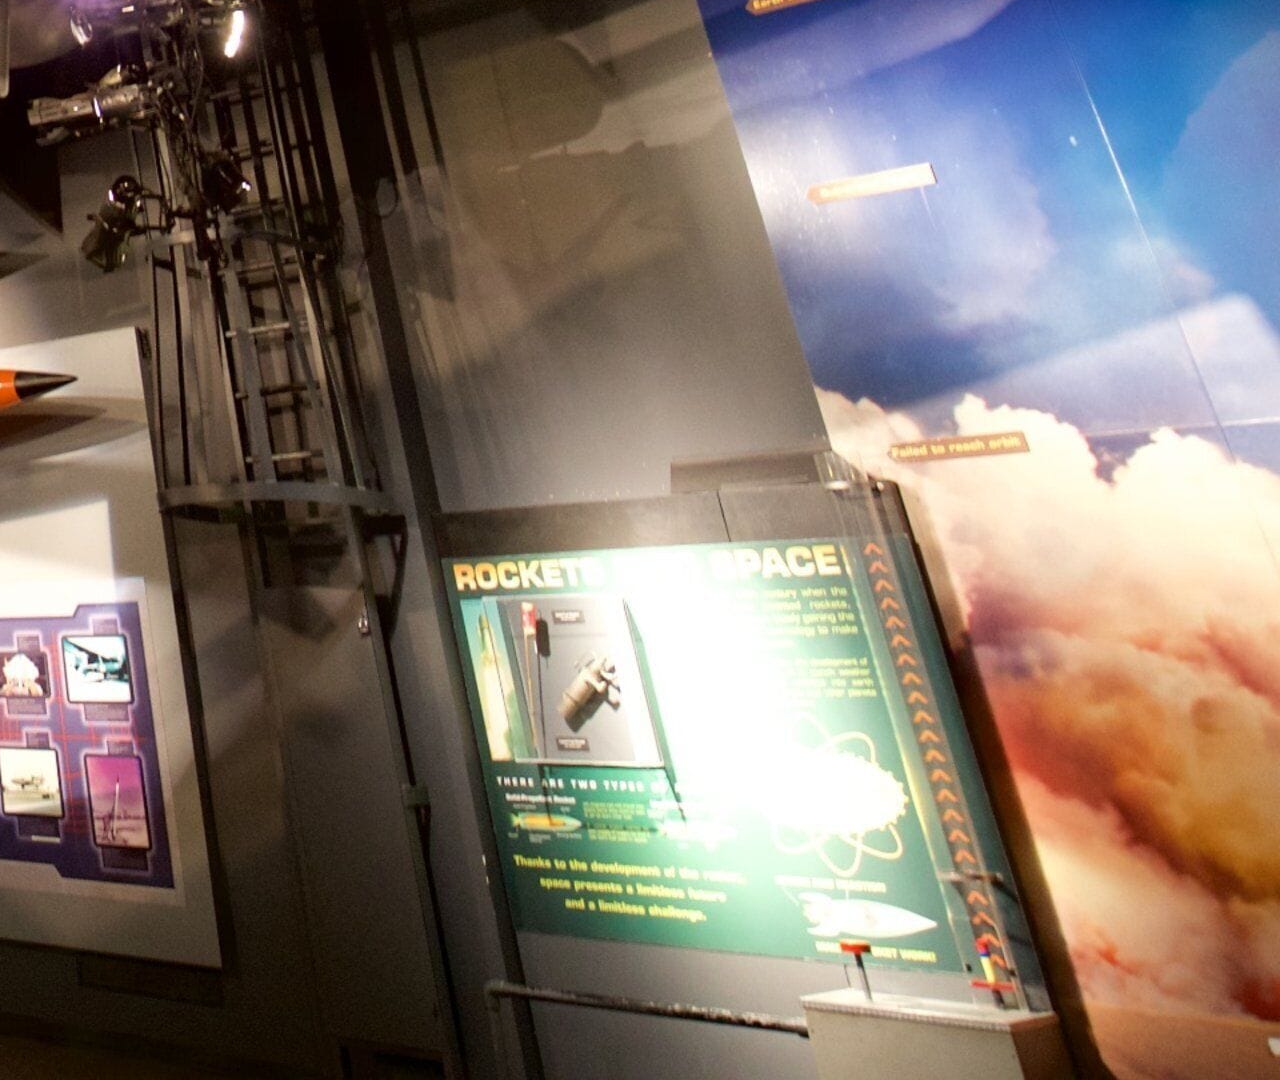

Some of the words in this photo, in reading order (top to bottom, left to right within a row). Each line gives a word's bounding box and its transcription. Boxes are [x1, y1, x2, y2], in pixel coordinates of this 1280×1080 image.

[891, 443, 928, 458] Failed
[930, 443, 946, 455] to
[948, 438, 986, 453] reach
[453, 557, 604, 592] ROCKETS
[496, 776, 535, 788] THERE
[541, 777, 565, 789] ARE
[571, 778, 598, 790] TWO
[603, 779, 645, 792] TYPES
[513, 854, 552, 869] Thanks
[554, 858, 567, 870] to
[569, 858, 589, 872] the
[590, 860, 662, 877] development
[663, 866, 676, 879] of
[539, 877, 572, 890] space
[573, 880, 624, 895] presents
[626, 884, 635, 895] a
[636, 882, 686, 899] limitless
[564, 898, 586, 911] and
[588, 901, 596, 911] a
[598, 899, 647, 915] limitless
